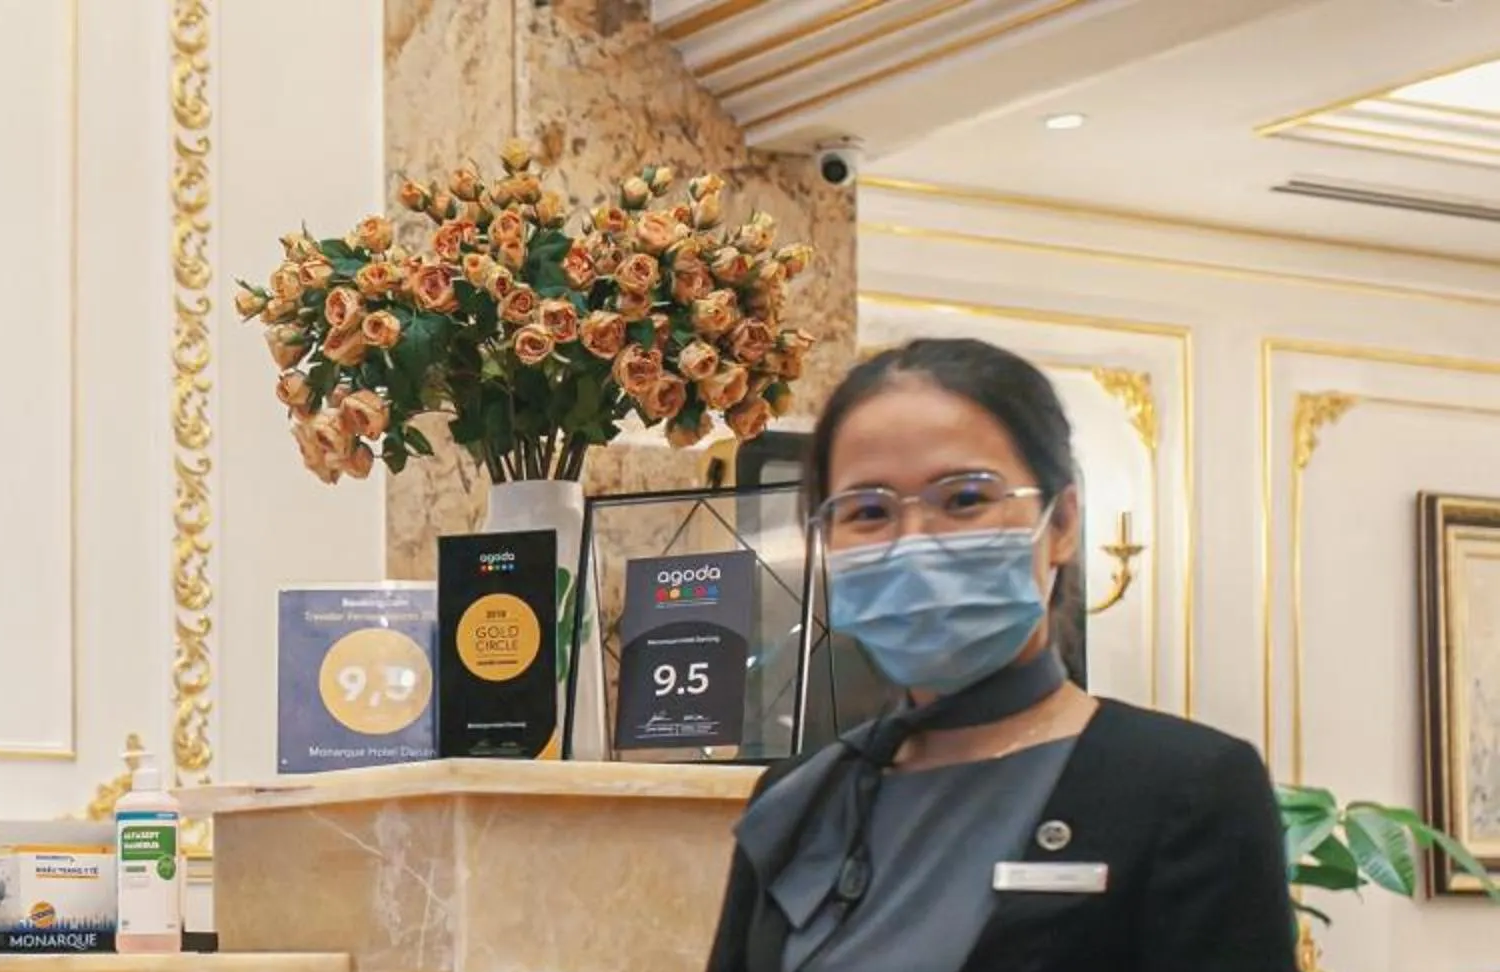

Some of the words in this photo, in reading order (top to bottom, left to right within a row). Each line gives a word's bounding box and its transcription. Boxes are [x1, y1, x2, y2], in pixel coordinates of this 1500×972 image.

[657, 564, 721, 587] agoda
[475, 625, 519, 639] GOLD
[475, 639, 518, 652] CIRCLE
[653, 662, 709, 697] 9.5
[9, 933, 98, 951] MONARQUE
